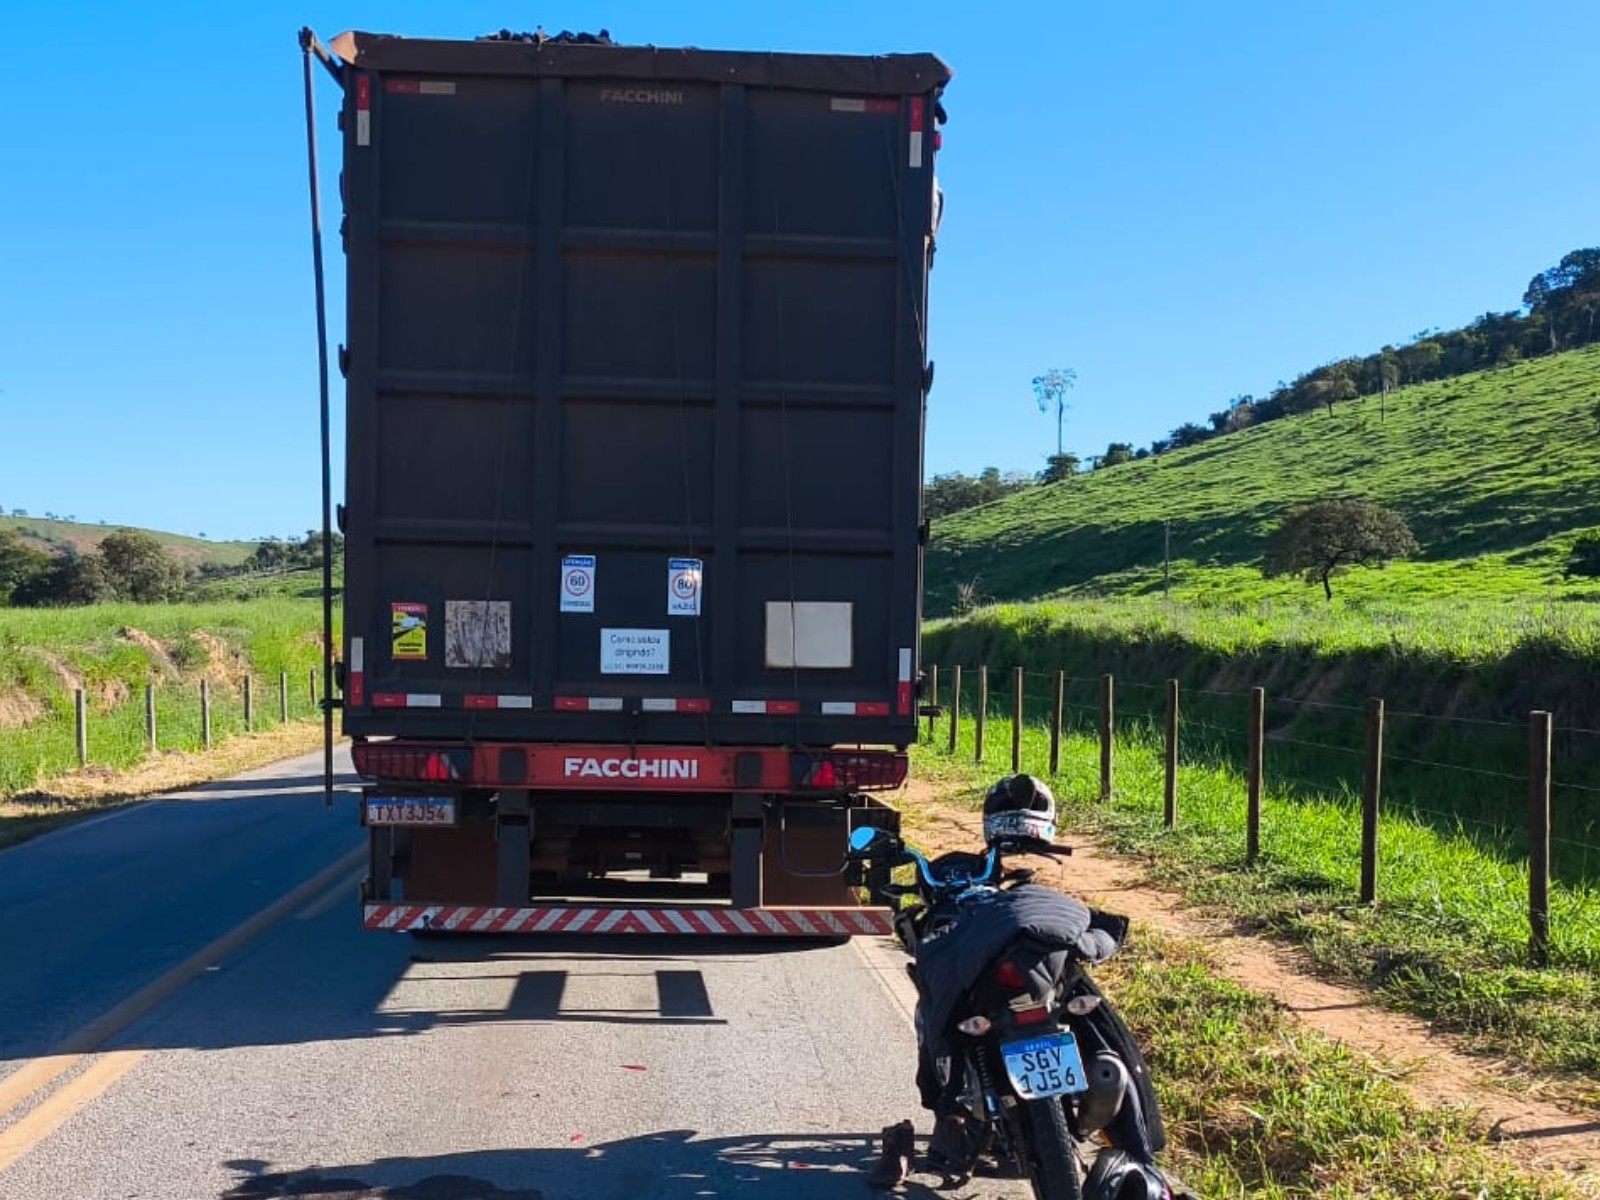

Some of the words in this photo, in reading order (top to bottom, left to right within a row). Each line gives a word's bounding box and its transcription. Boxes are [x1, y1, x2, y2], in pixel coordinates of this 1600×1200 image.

[601, 88, 683, 104] FACCHINI
[570, 575, 585, 587] 60
[564, 757, 698, 778] FACCHINI
[375, 805, 446, 821] TXT3J54
[1019, 1066, 1076, 1094] 1J56
